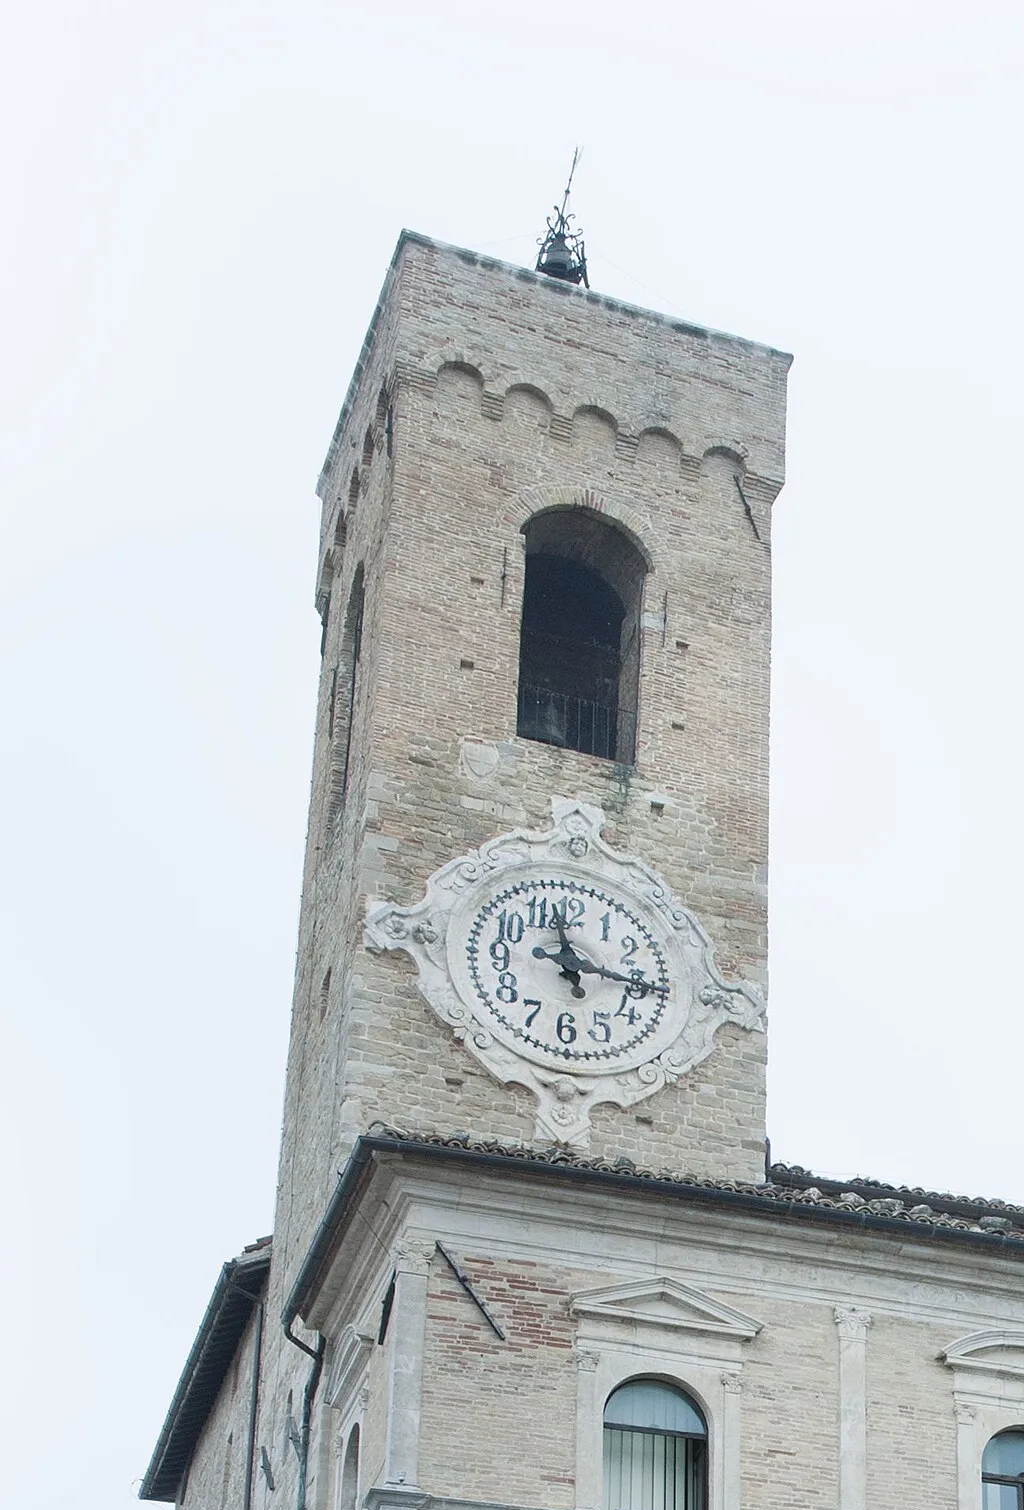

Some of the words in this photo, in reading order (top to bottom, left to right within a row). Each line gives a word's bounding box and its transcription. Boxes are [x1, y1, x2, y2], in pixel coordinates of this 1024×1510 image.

[496, 908, 526, 944] 10
[525, 895, 550, 929] 11
[557, 895, 586, 929] 12
[600, 911, 612, 942] 1
[488, 938, 510, 972] 9
[620, 935, 640, 967] 2
[495, 971, 519, 1004] 8
[522, 998, 542, 1028] 7
[587, 1010, 612, 1043] 5
[613, 994, 642, 1026] 4
[556, 1012, 577, 1044] 6
